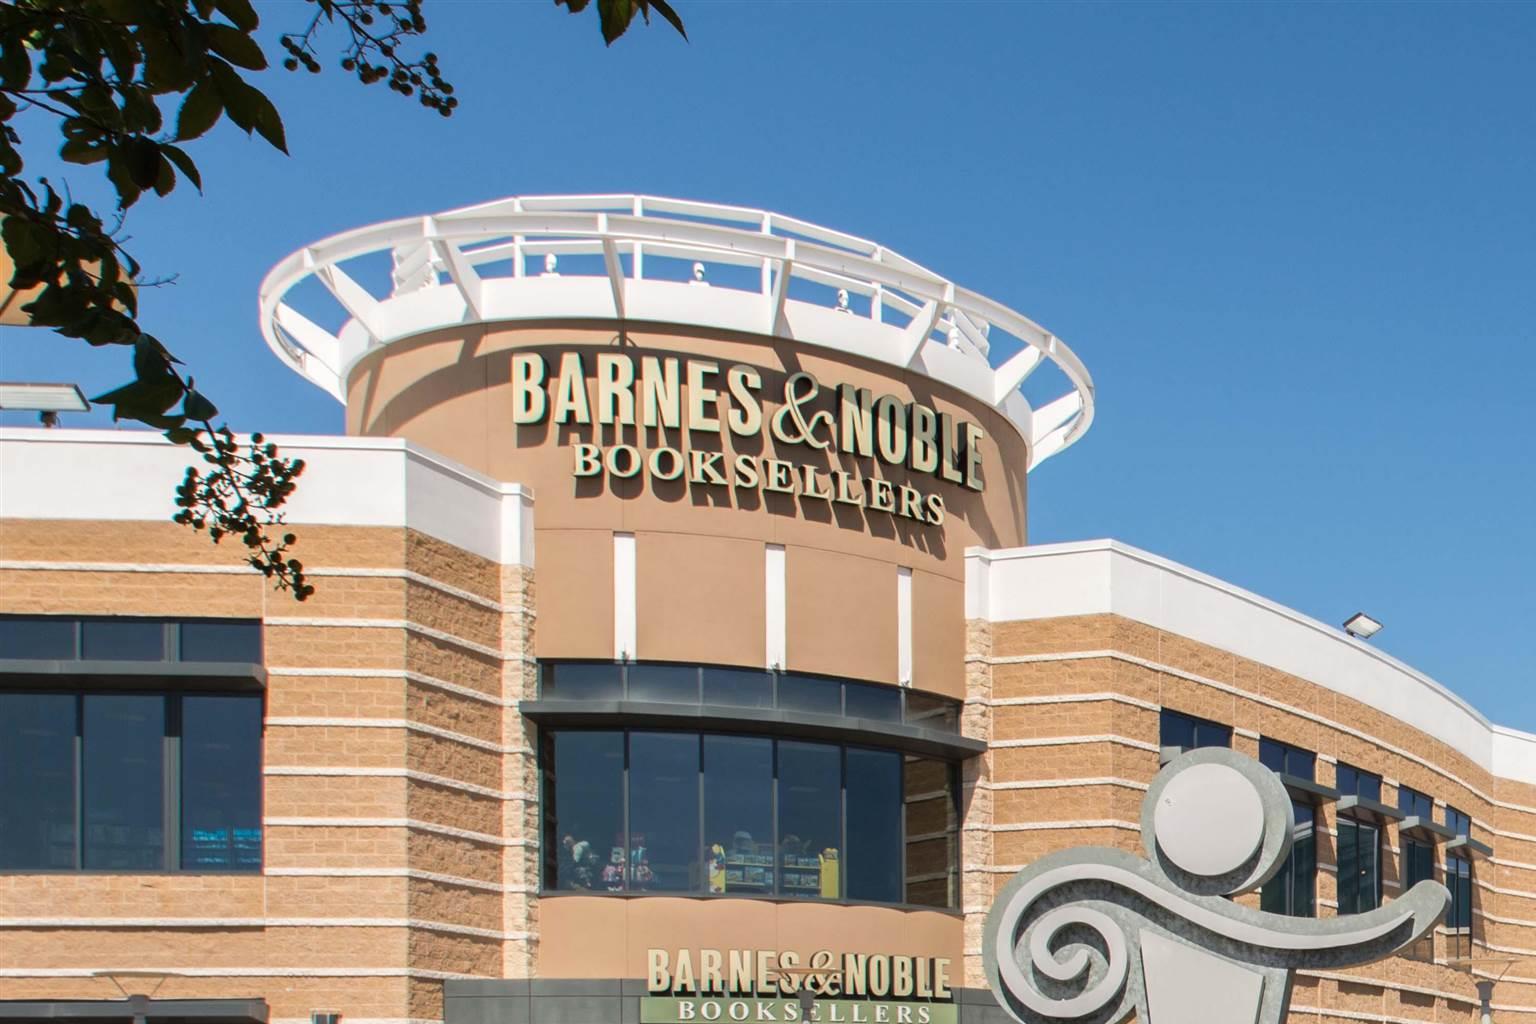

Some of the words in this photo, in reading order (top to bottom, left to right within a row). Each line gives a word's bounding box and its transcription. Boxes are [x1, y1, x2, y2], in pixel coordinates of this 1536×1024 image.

[511, 352, 763, 437] BARNES
[836, 382, 985, 492] NOBLE
[573, 442, 946, 527] BOOKSELLERS
[647, 948, 800, 994] BARNES
[844, 952, 952, 998] NOBLE
[677, 1000, 931, 1024] BOOKSELLERS
